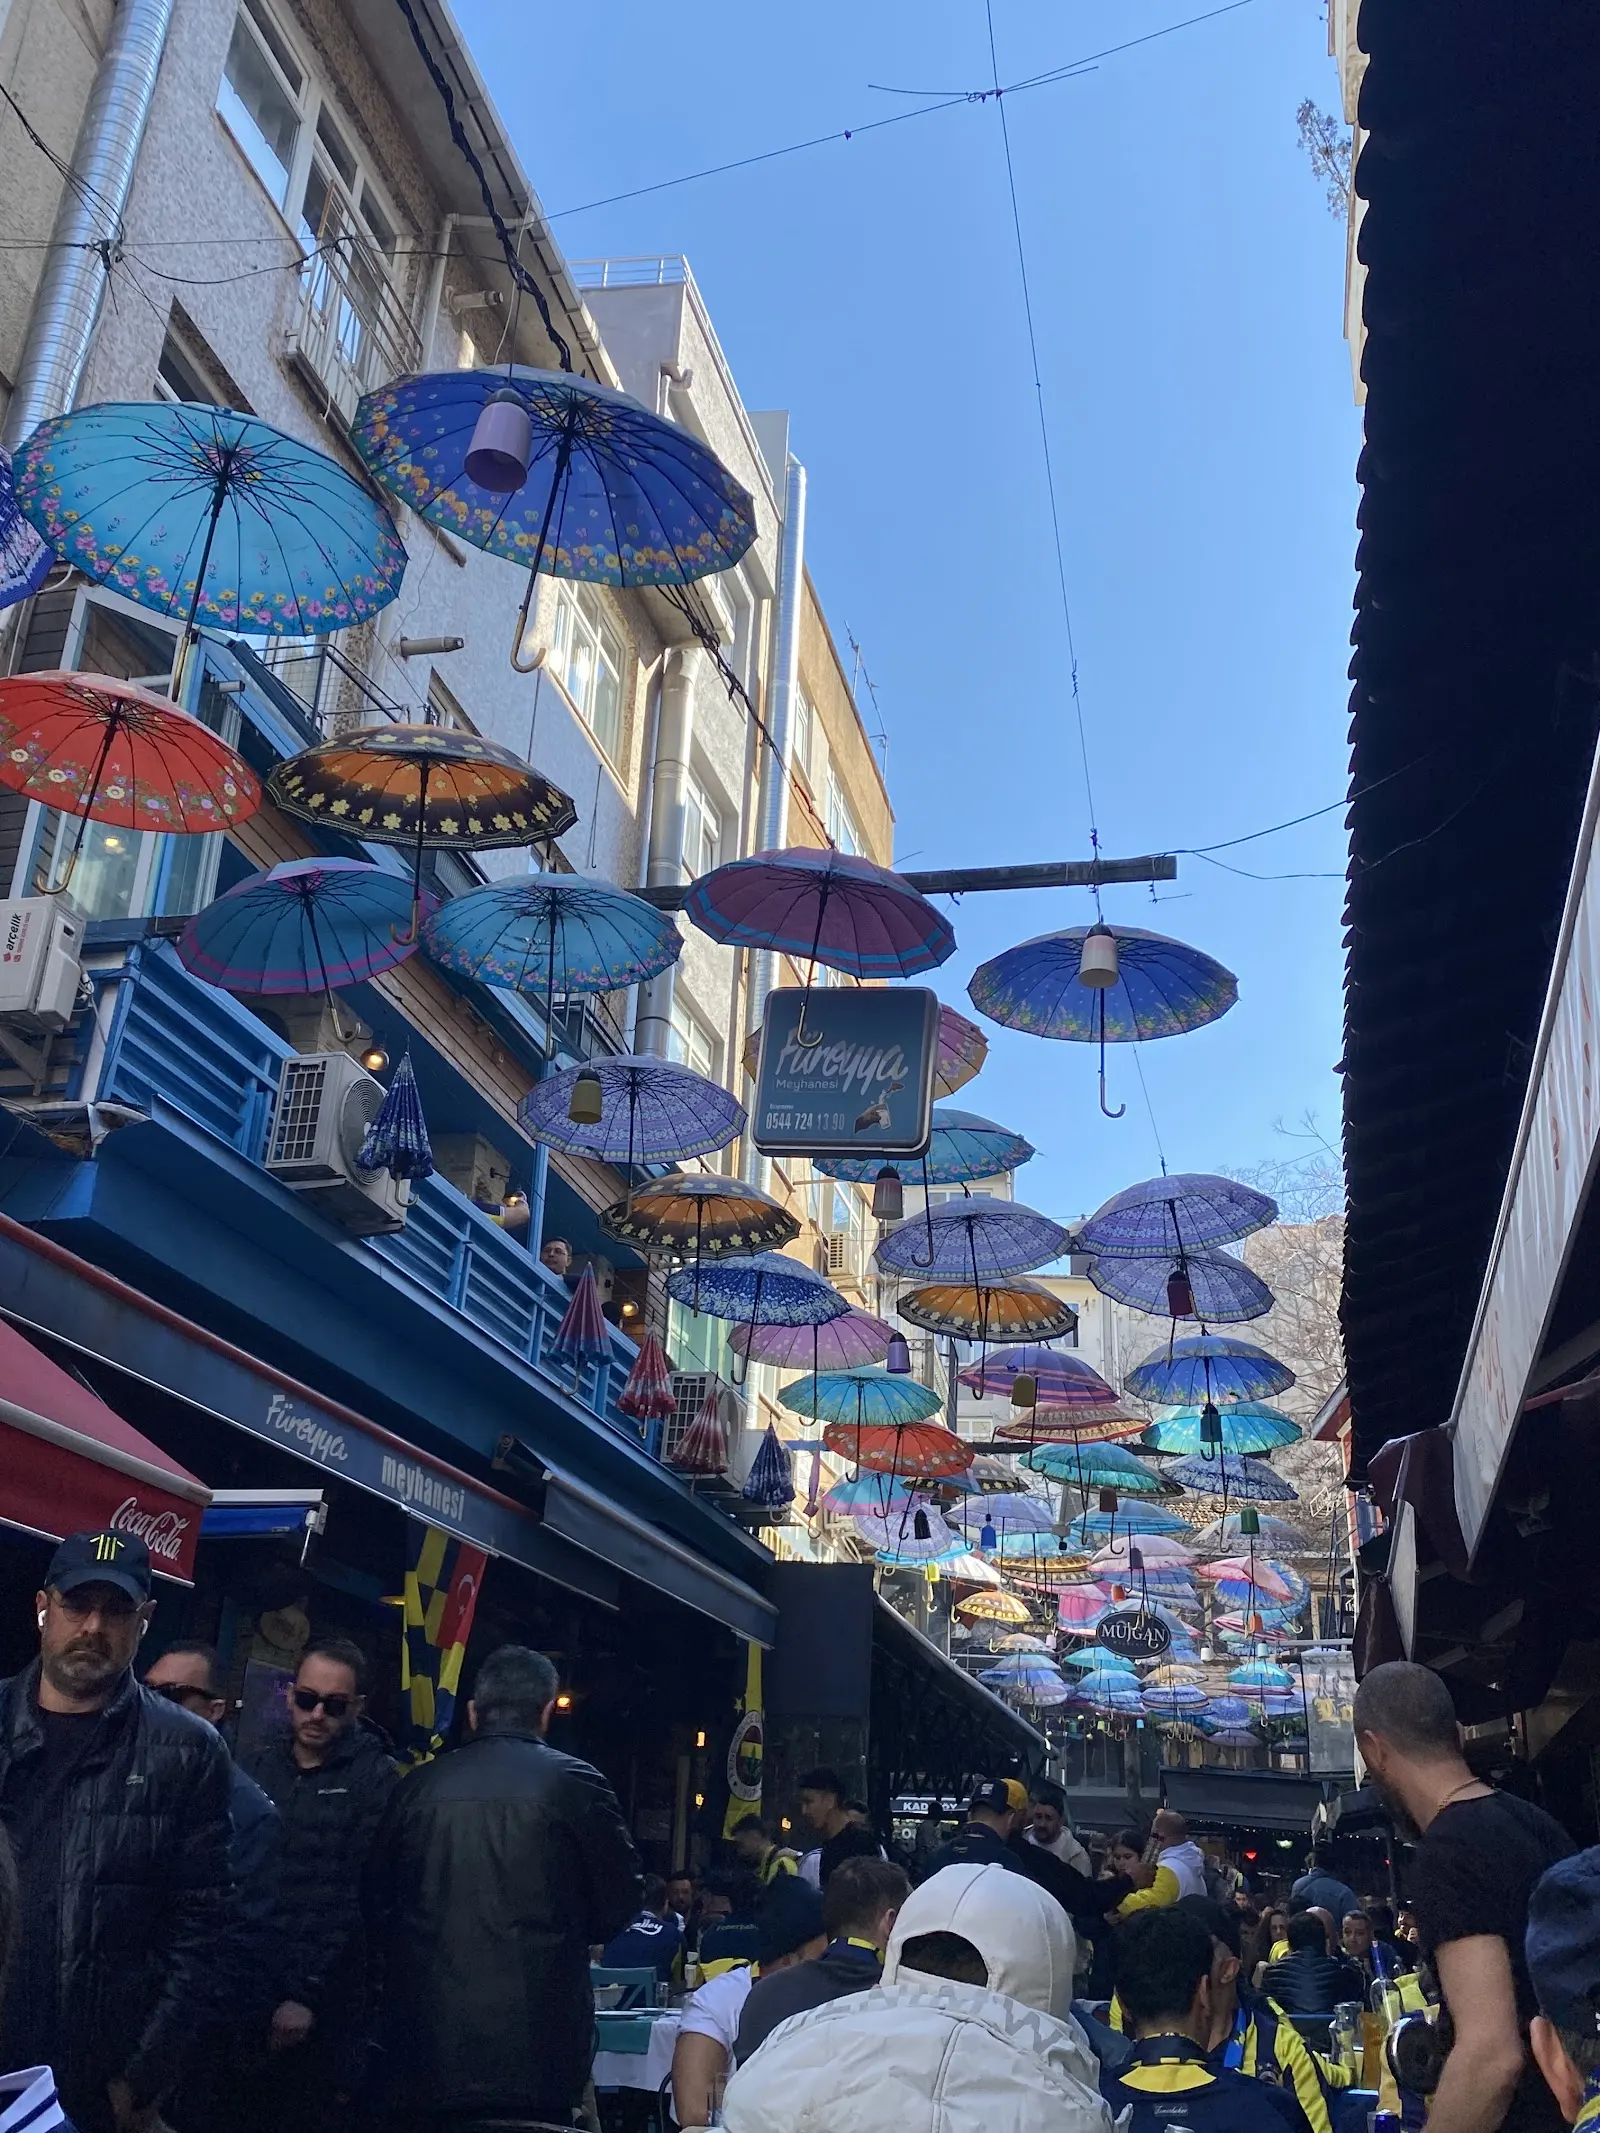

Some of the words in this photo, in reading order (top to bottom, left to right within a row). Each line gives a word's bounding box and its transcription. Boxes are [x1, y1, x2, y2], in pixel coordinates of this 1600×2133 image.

[6, 913, 22, 951] arçelik
[776, 1078, 839, 1092] Meyhanesi
[765, 1113, 792, 1130] 0544
[794, 1113, 813, 1130] 724
[817, 1114, 830, 1130] 13
[266, 1394, 348, 1461] Füreyya
[381, 1455, 465, 1521] meyhanesi
